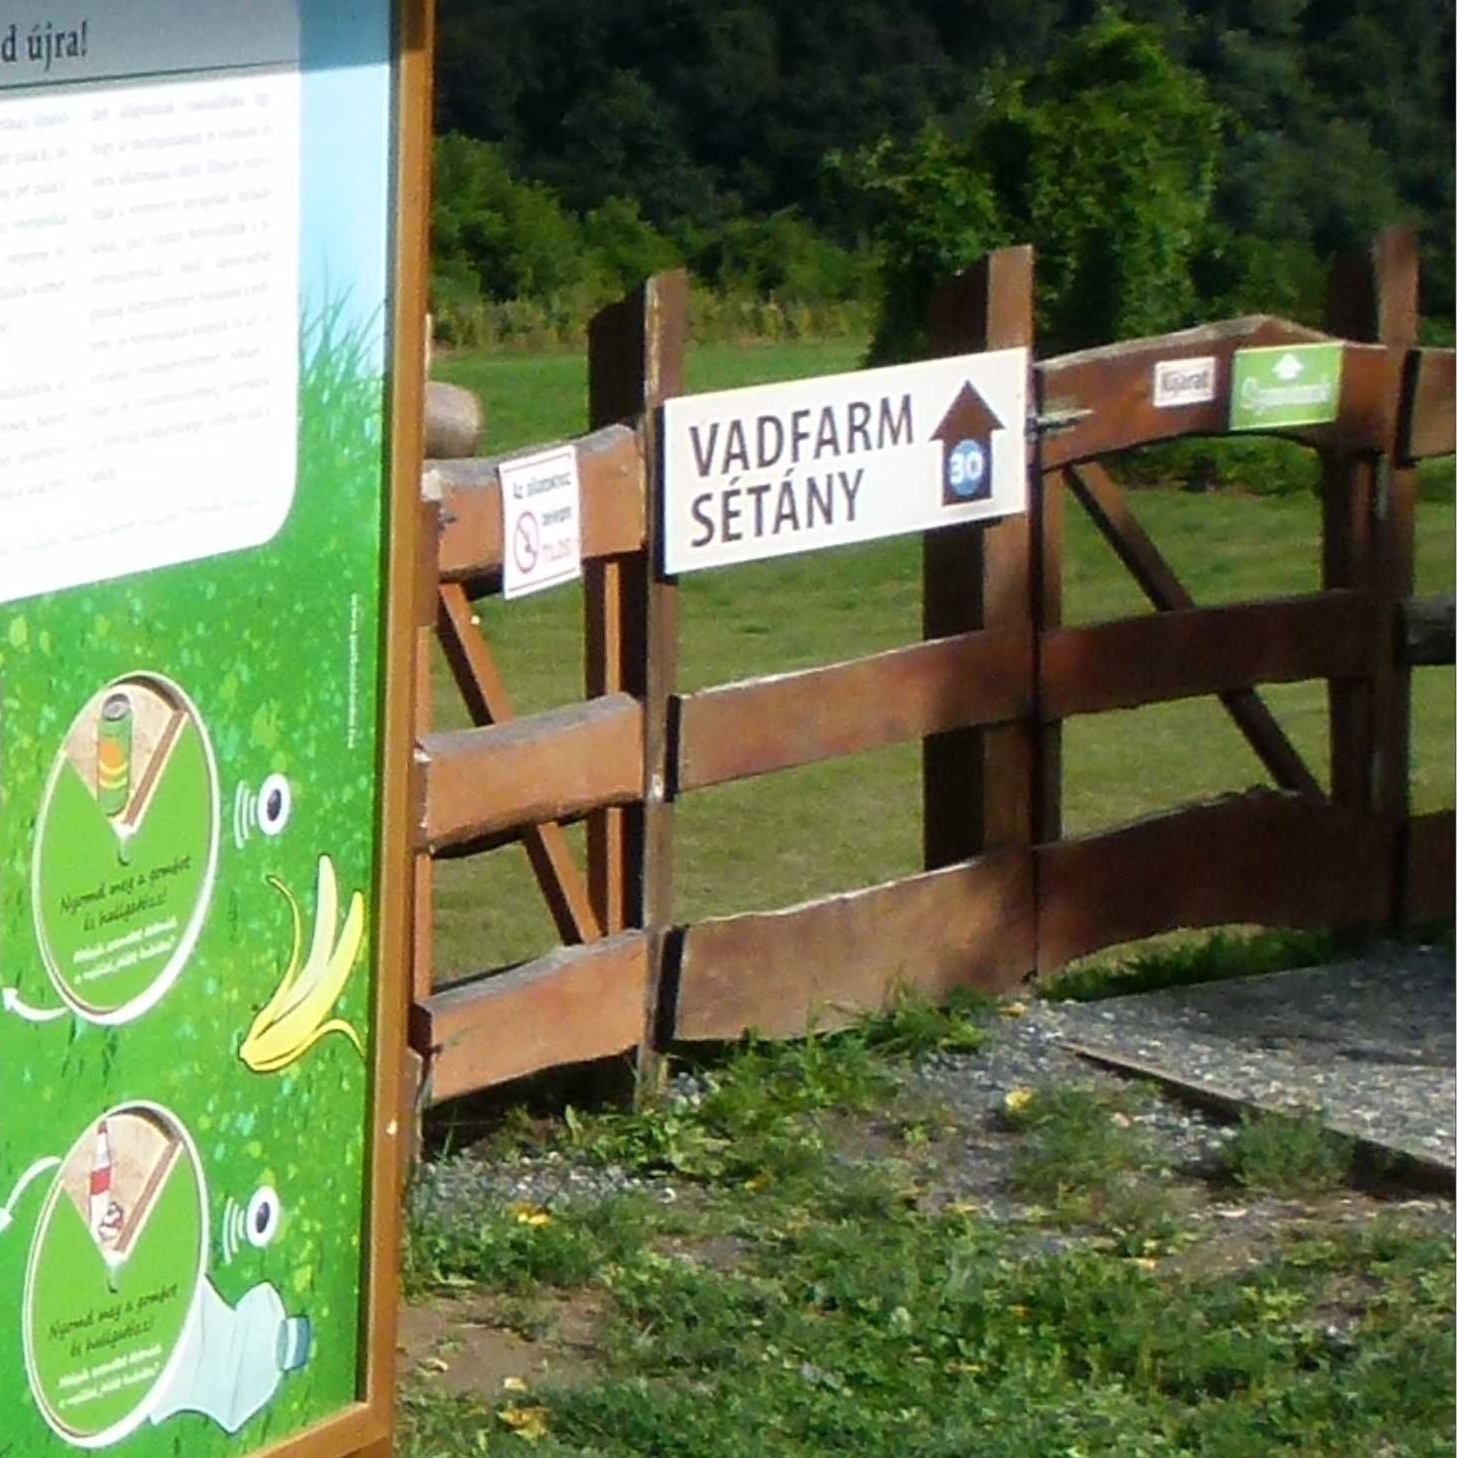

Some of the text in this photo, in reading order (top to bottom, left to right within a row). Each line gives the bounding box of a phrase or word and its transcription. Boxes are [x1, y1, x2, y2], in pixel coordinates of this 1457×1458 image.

[27, 19, 88, 72] újra!
[689, 394, 914, 477] VADFARM
[949, 447, 984, 484] 30
[690, 467, 865, 548] SÉTÁNY
